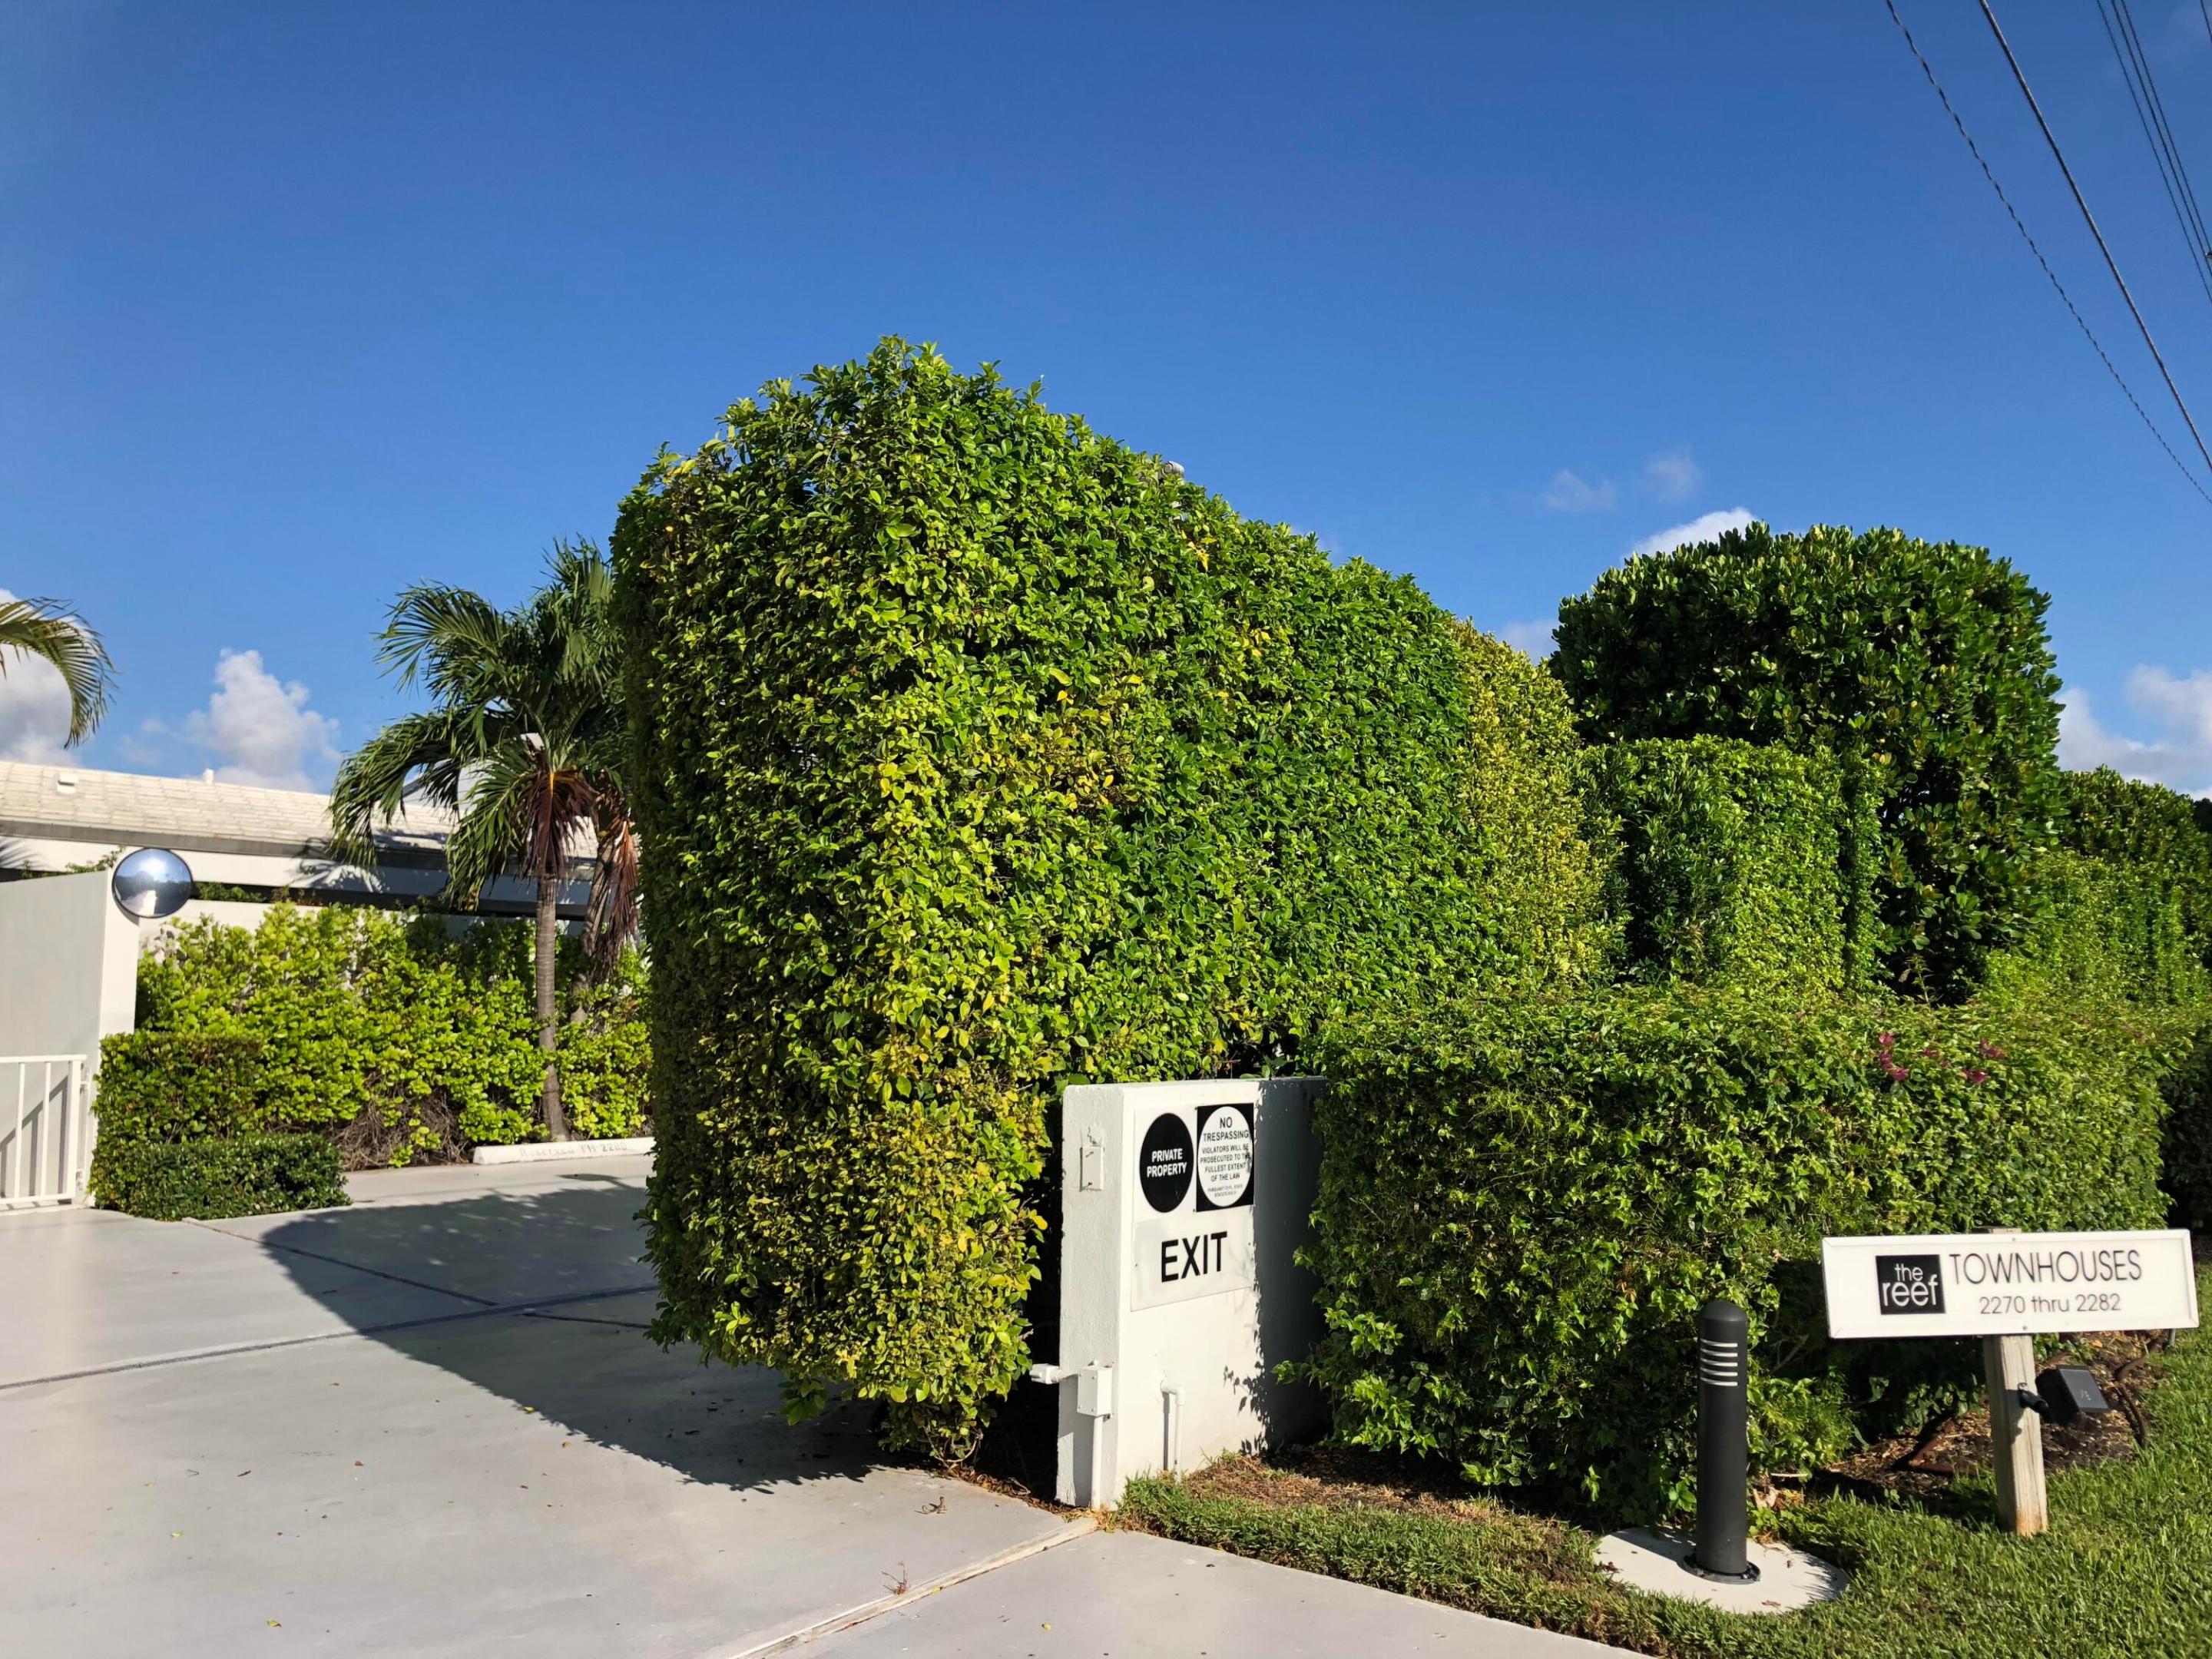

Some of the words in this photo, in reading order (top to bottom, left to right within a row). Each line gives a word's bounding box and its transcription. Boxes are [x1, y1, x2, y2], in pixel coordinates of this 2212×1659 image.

[1220, 1117, 1233, 1128] NO
[1203, 1129, 1249, 1142] TRESPASSING
[1151, 1148, 1183, 1163] PRIVATE
[1202, 1145, 1229, 1154] VIOLATORS
[1200, 1154, 1233, 1164] PROSECUTED
[1147, 1161, 1187, 1177] PROPERTY
[1205, 1164, 1227, 1173] FULLEST
[1227, 1162, 1246, 1171] EXTENT
[1230, 1172, 1240, 1181] LAW
[1161, 1230, 1227, 1283] EXIT
[1894, 1263, 1924, 1282] the
[1949, 1249, 2142, 1285] TOWNHOUSES
[1881, 1273, 1939, 1307] reef
[1979, 1296, 2025, 1314] 2270
[2032, 1296, 2070, 1313] thru
[2075, 1293, 2121, 1312] 2282
